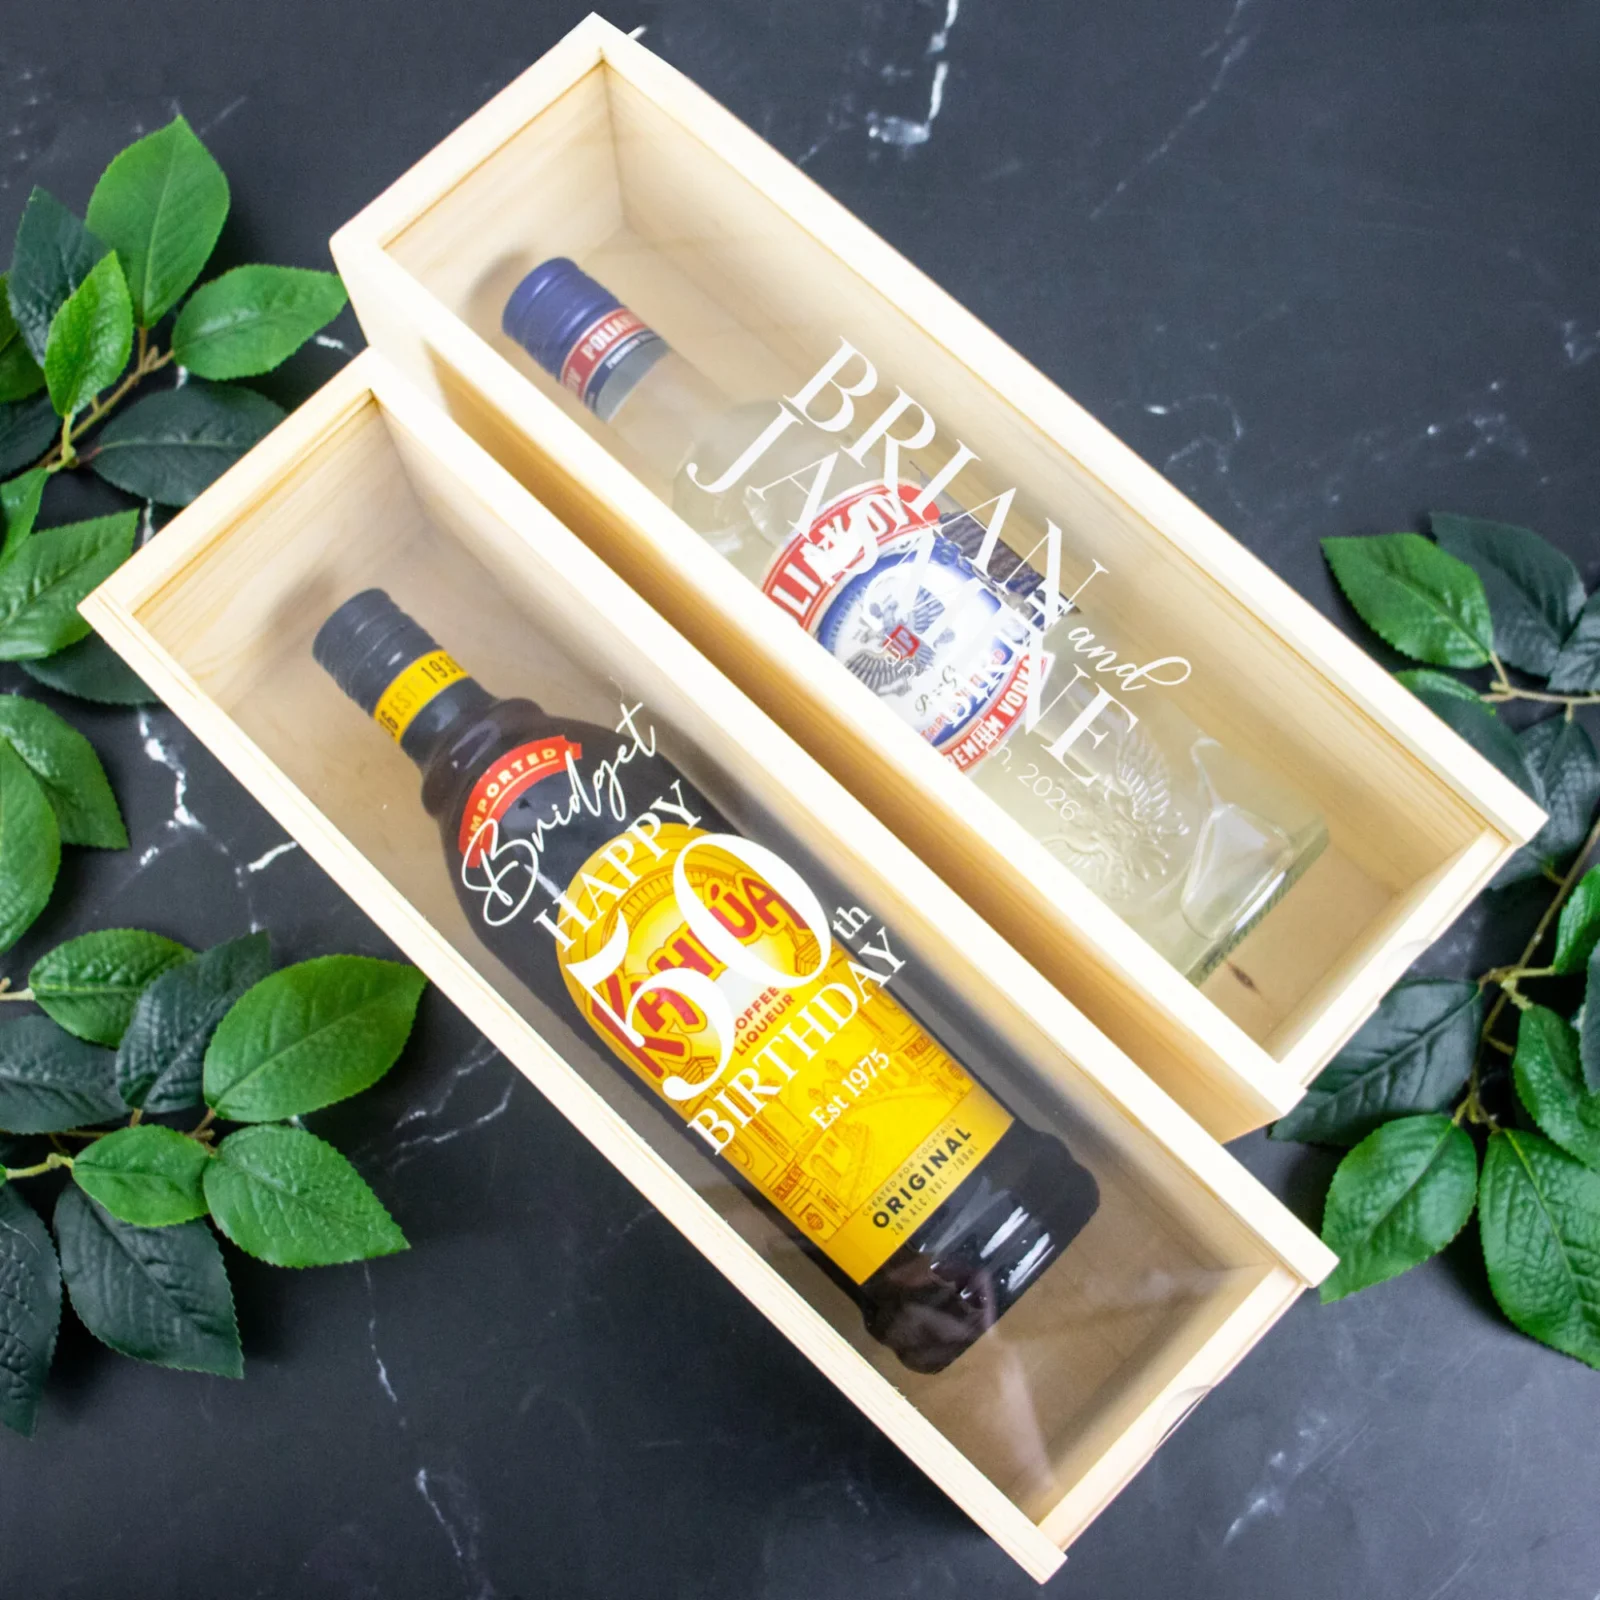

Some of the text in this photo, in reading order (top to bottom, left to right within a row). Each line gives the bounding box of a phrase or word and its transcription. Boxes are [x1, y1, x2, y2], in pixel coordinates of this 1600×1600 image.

[783, 336, 1109, 633] BRIAN
[1067, 623, 1192, 692] and
[686, 402, 1139, 786] JASMINE
[462, 702, 656, 927] Bridget
[1017, 763, 1082, 821] 2026
[533, 780, 702, 952] HAPPY
[687, 927, 906, 1155] BIRTHDAY
[734, 993, 795, 1056] LIQUEUR
[809, 1047, 890, 1130] Est 1975
[862, 1180, 897, 1216] CREATED
[872, 1127, 972, 1228] ORIGINAL
